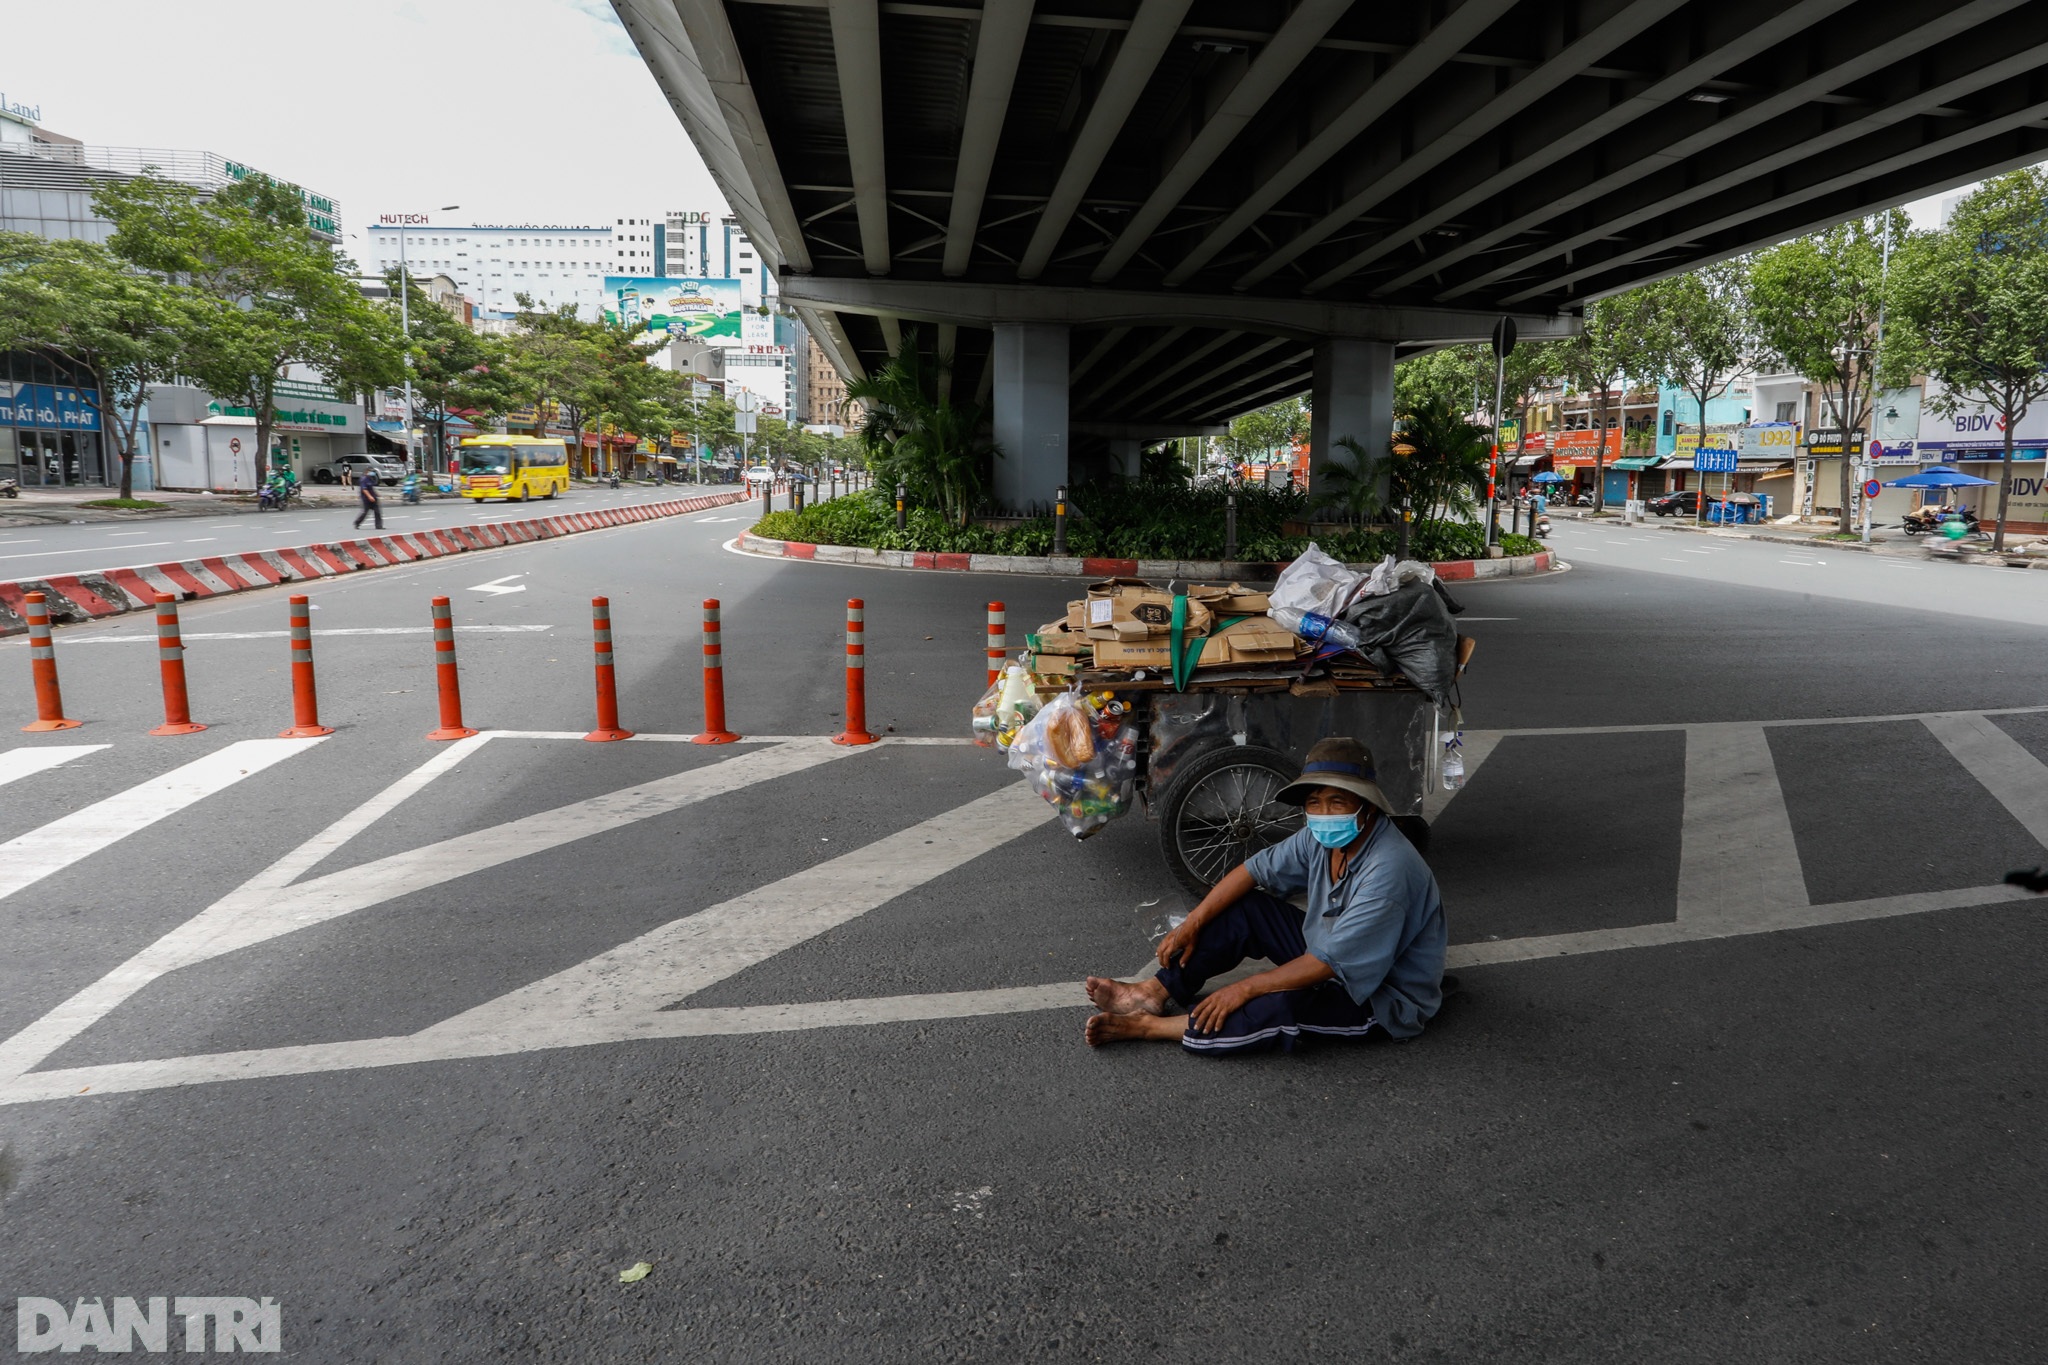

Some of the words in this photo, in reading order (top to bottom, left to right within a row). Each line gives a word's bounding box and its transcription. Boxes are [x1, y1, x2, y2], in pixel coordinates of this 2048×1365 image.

[1, 92, 41, 121] Land
[311, 194, 333, 213] KHOA
[380, 214, 429, 224] HUTECH
[0, 403, 34, 421] THẤT
[37, 407, 62, 423] HÒA
[65, 410, 93, 425] PHÁT
[1956, 415, 1995, 432] BIDV
[1498, 420, 1518, 443] PHỞ
[1759, 430, 1792, 447] 1992
